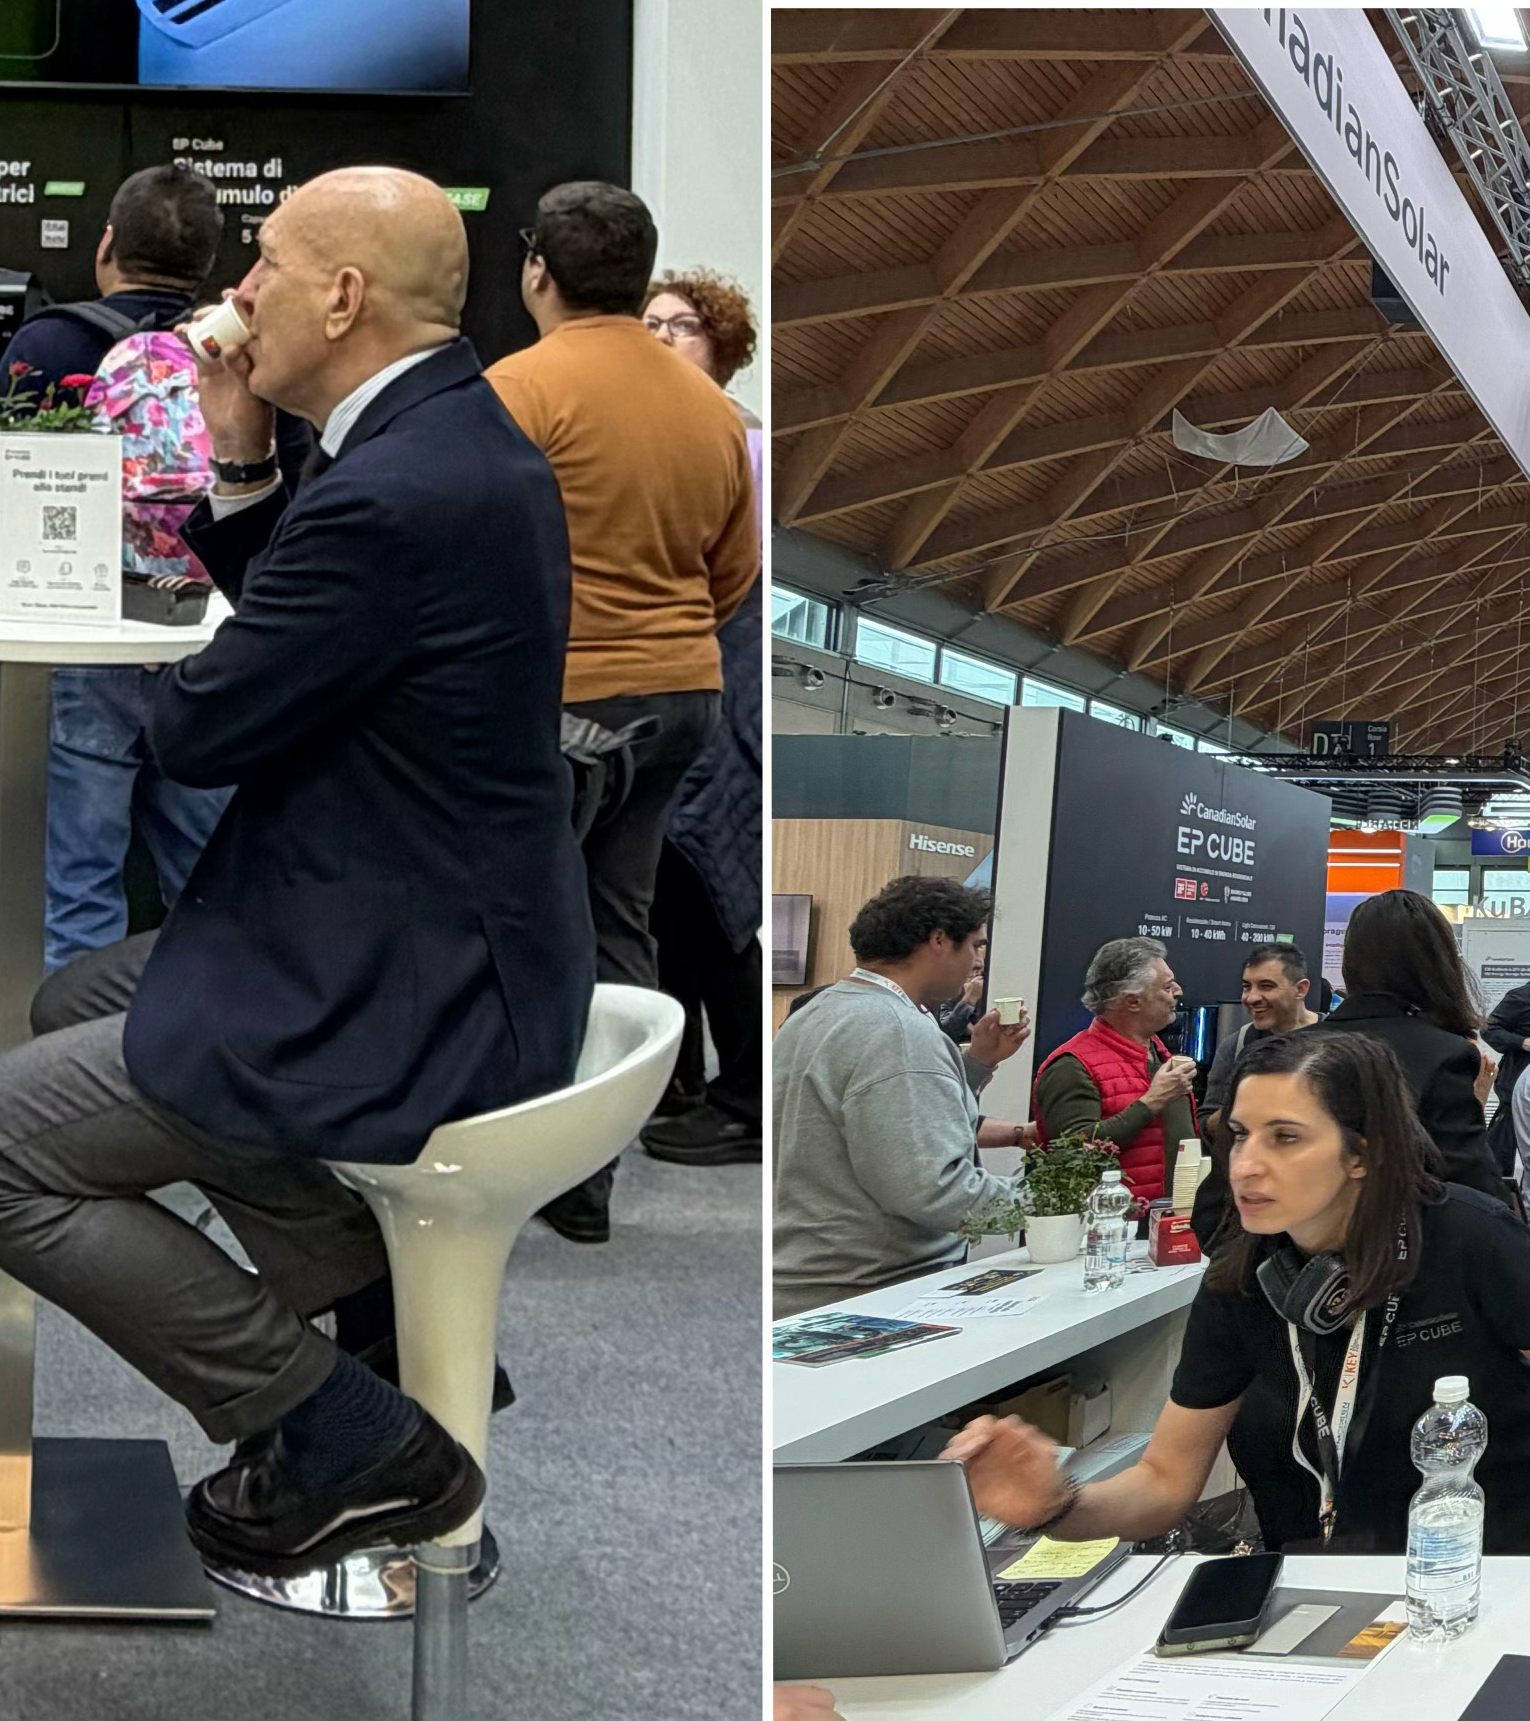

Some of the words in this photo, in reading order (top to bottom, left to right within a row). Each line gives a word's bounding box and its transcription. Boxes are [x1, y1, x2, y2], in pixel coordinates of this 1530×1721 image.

[1197, 802, 1257, 830] CanadianSolar
[908, 832, 975, 858] Hisense
[1177, 825, 1204, 855] EP
[1206, 833, 1256, 866] CUBE
[1397, 1333, 1418, 1347] EP
[1419, 1321, 1463, 1342] CUBE
[1345, 1352, 1359, 1374] KEY
[1309, 1396, 1331, 1440] CUBE
